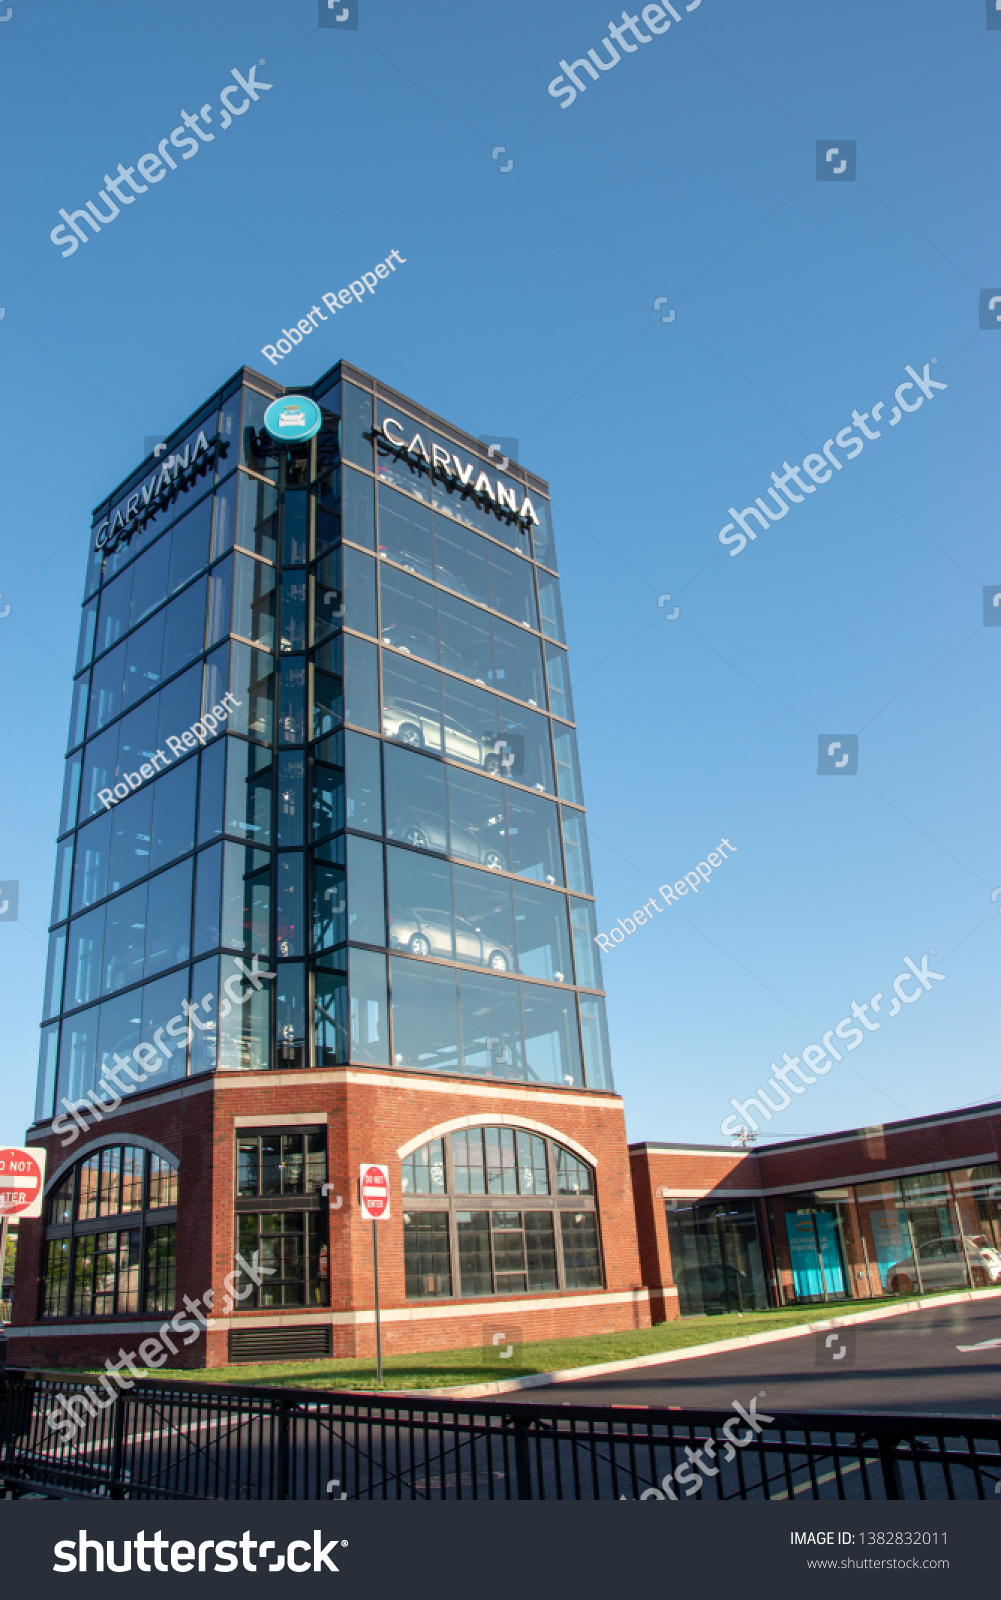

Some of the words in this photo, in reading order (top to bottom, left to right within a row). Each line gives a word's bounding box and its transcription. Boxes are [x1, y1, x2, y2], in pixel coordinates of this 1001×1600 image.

[96, 430, 209, 548] CARVANA
[382, 418, 540, 526] CARVANA
[0, 1160, 5, 1171] O
[10, 1160, 33, 1172] NOT
[367, 1199, 384, 1208] ENTER
